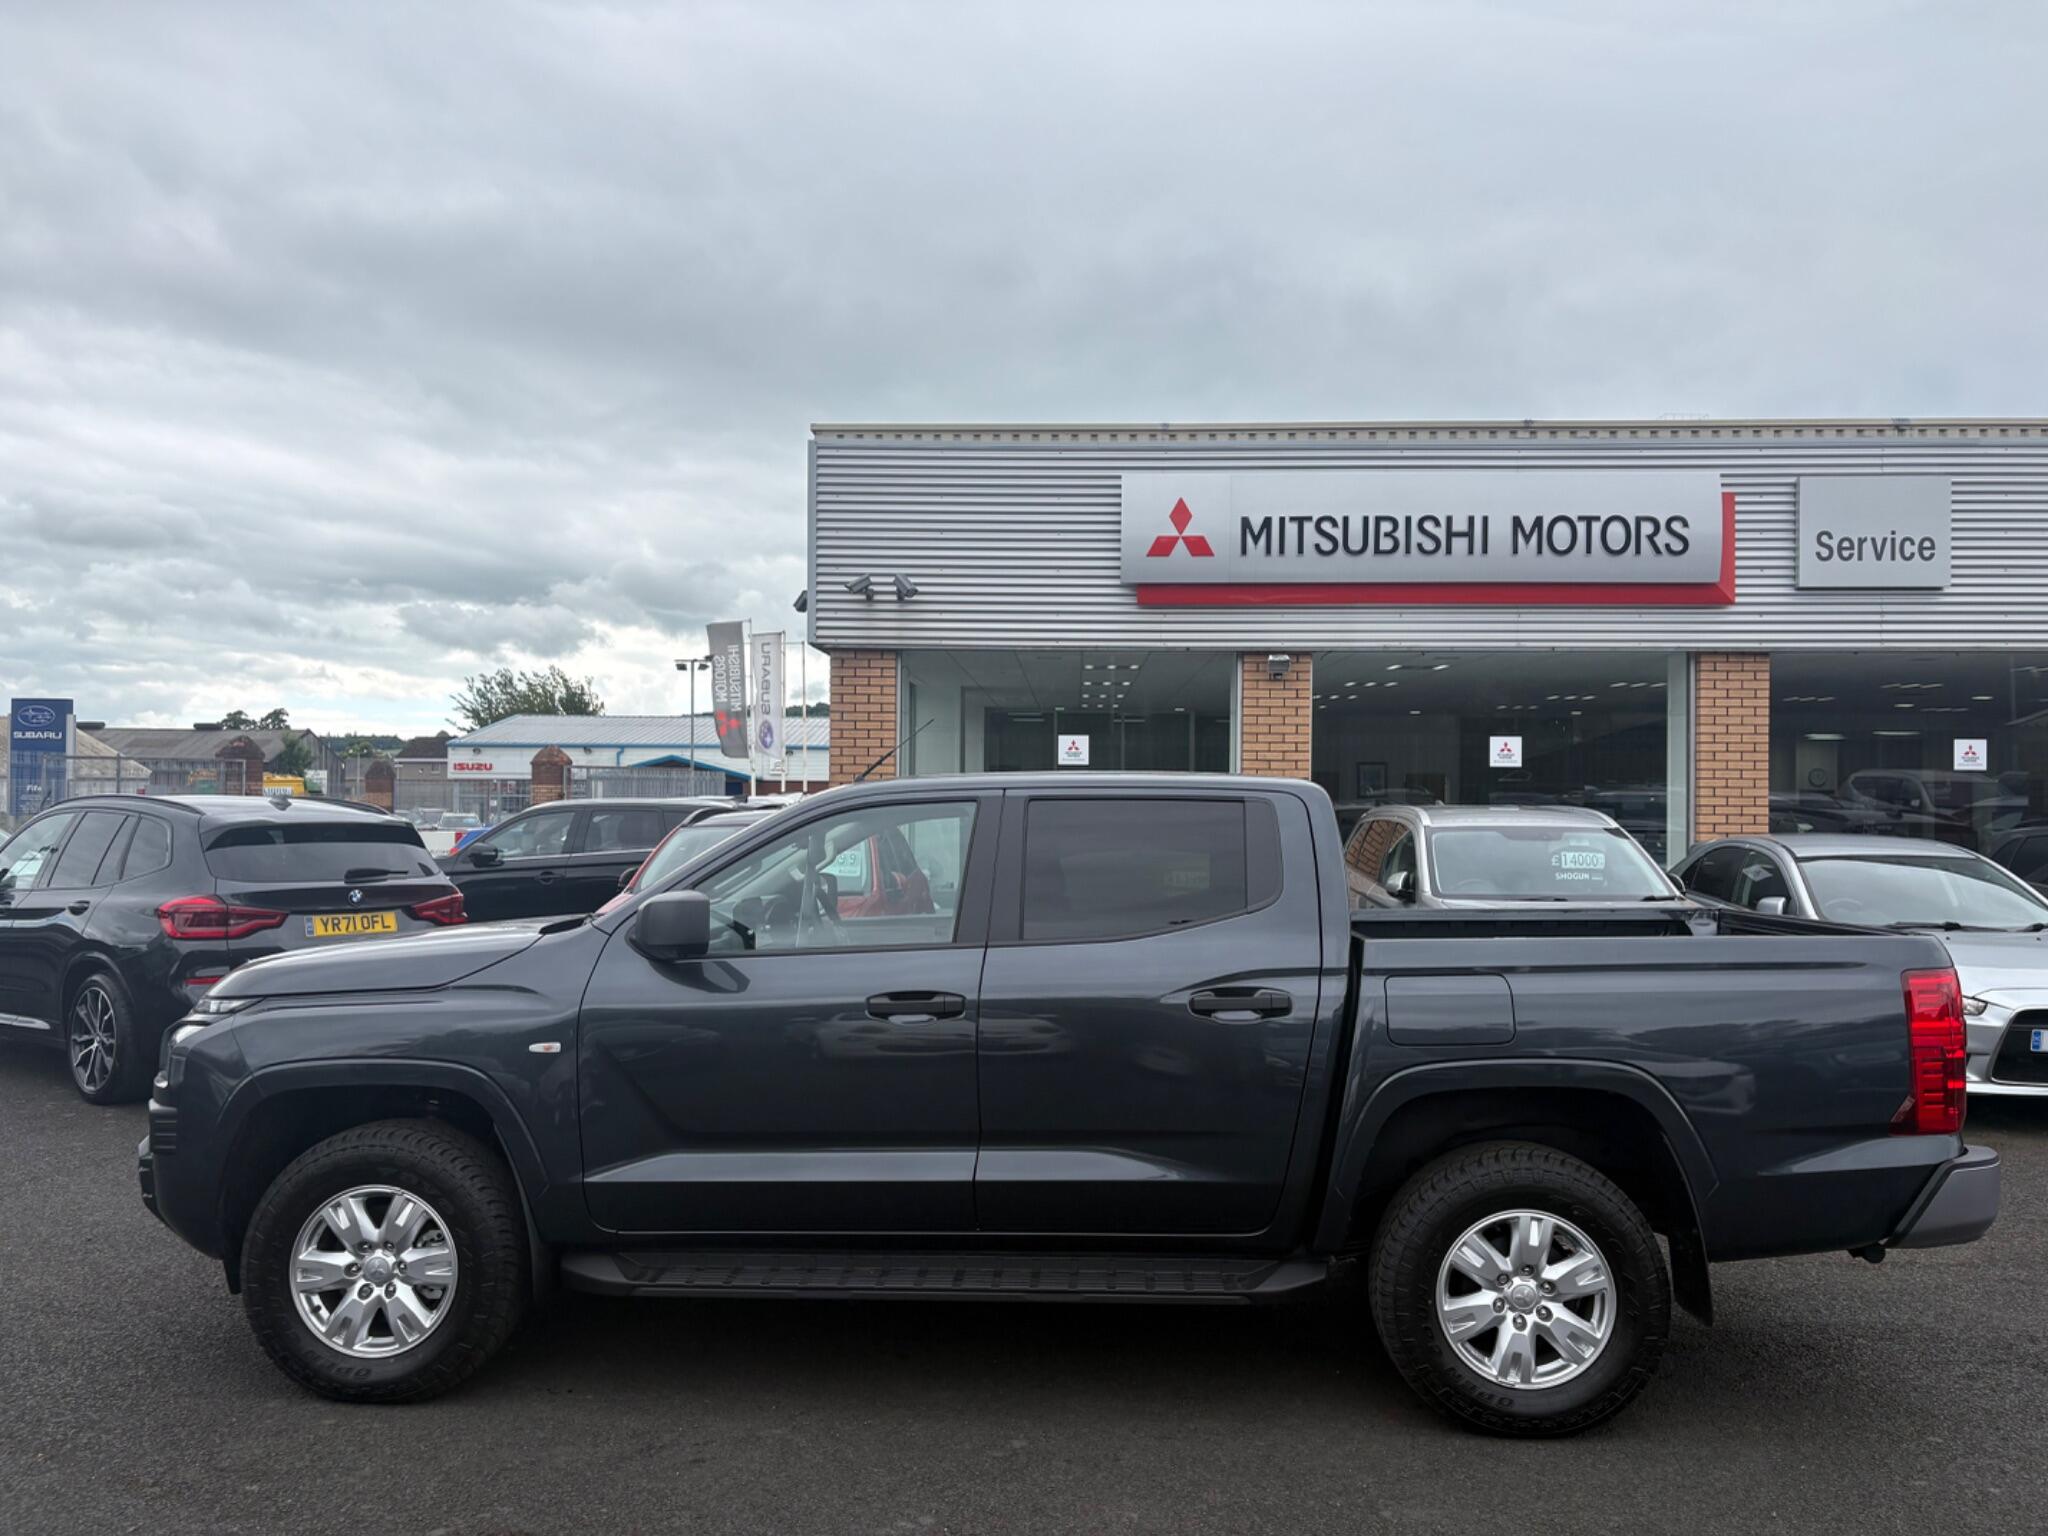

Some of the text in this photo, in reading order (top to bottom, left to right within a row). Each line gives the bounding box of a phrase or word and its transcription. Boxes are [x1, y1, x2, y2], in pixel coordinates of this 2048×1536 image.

[1239, 513, 1691, 557] MITSUBISHI MOTORS
[1815, 529, 1937, 562] Service
[13, 731, 63, 740] SUBARU
[453, 762, 493, 771] ISUZU
[1555, 871, 1590, 881] SHOGUN
[319, 915, 358, 933] YR71
[360, 914, 392, 930] OFL
